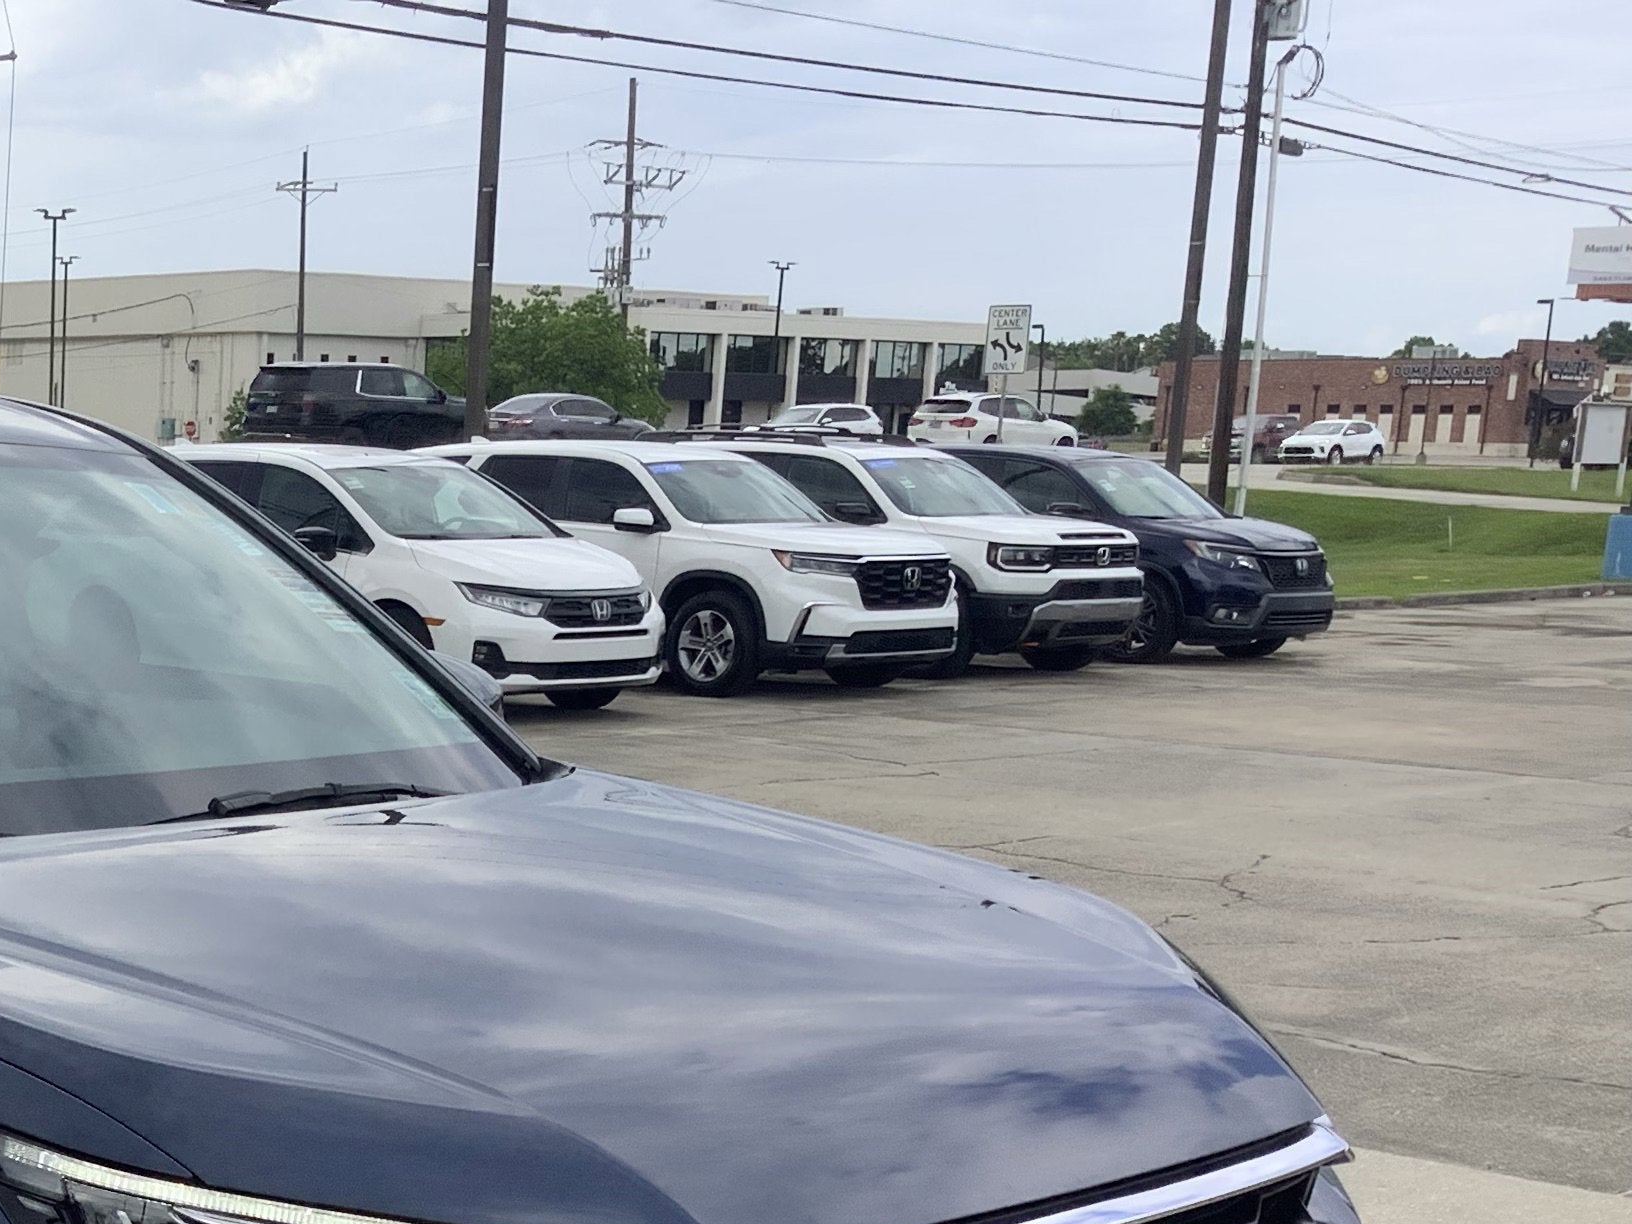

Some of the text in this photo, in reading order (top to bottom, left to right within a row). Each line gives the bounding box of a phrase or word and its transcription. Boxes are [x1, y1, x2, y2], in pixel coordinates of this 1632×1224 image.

[1584, 244, 1624, 253] Mental
[992, 308, 1028, 318] CENTER
[997, 319, 1021, 327] LANE
[992, 361, 1017, 371] ONLY
